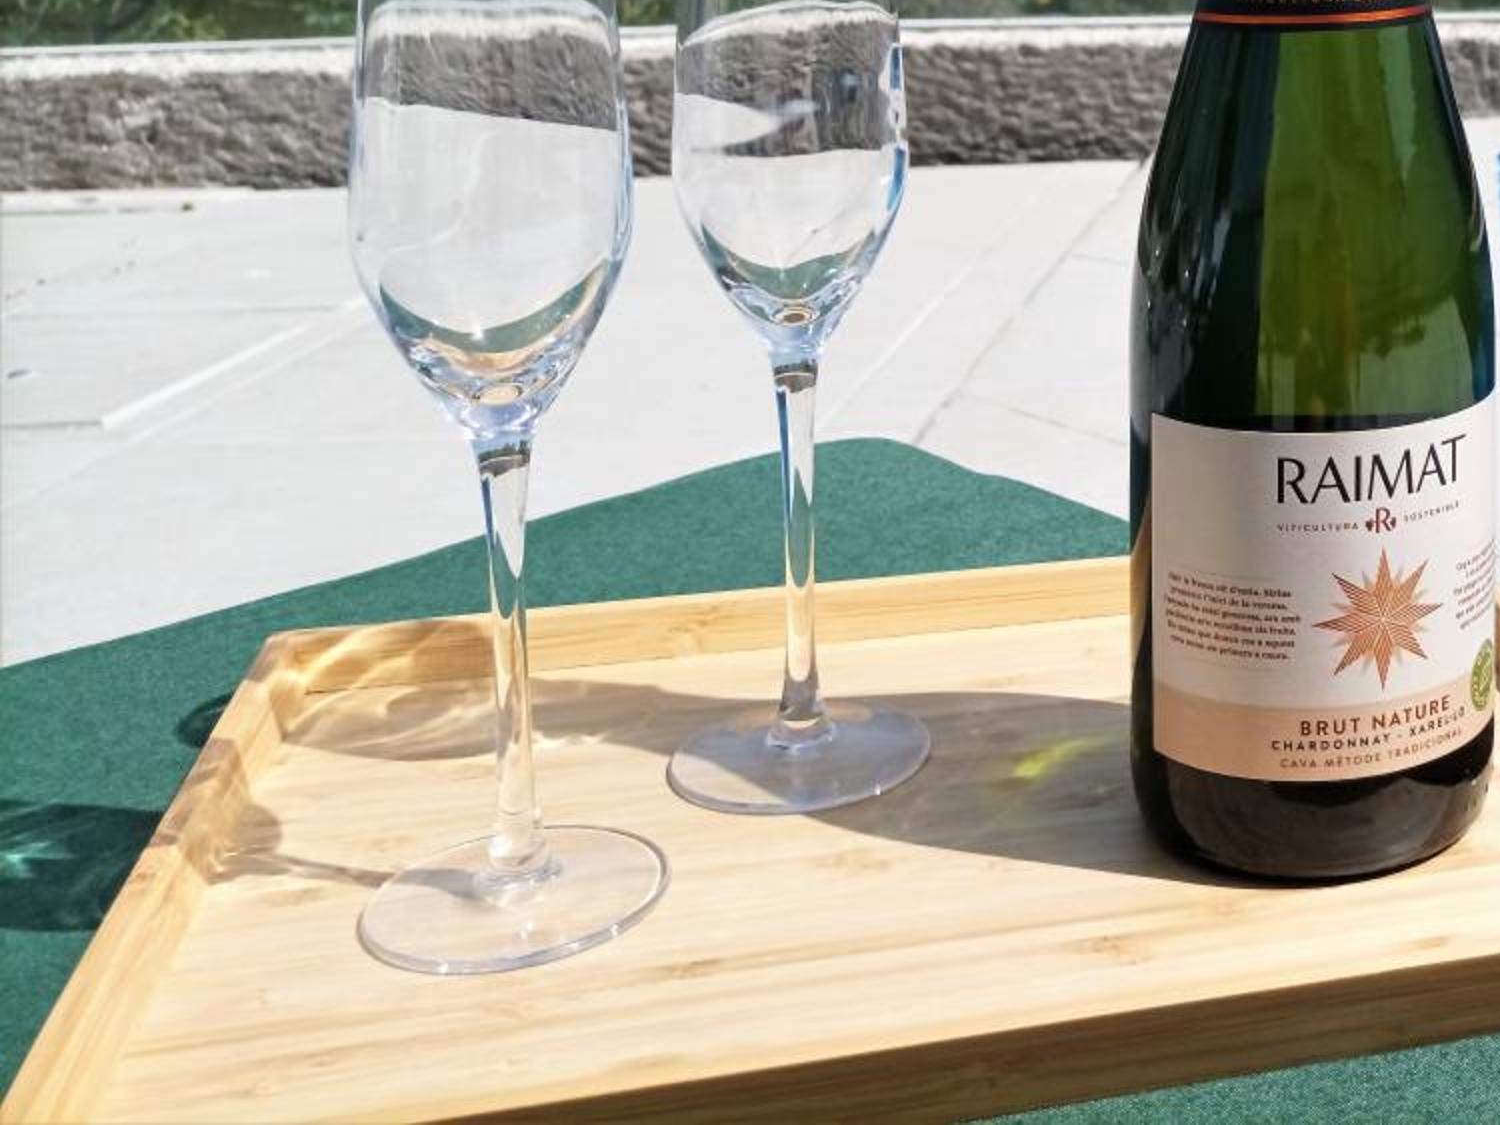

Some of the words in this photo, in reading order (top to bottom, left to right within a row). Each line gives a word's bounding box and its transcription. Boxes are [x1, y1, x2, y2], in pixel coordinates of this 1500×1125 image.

[1277, 433, 1466, 504] RAIMAT
[1277, 522, 1359, 532] VITICULTURA
[1300, 717, 1361, 737] BRUT
[1372, 694, 1451, 730] NATURE
[1271, 733, 1391, 752] CHARDONNAY
[1280, 758, 1318, 769] CAVA
[1388, 729, 1462, 759] TRADICIONAL
